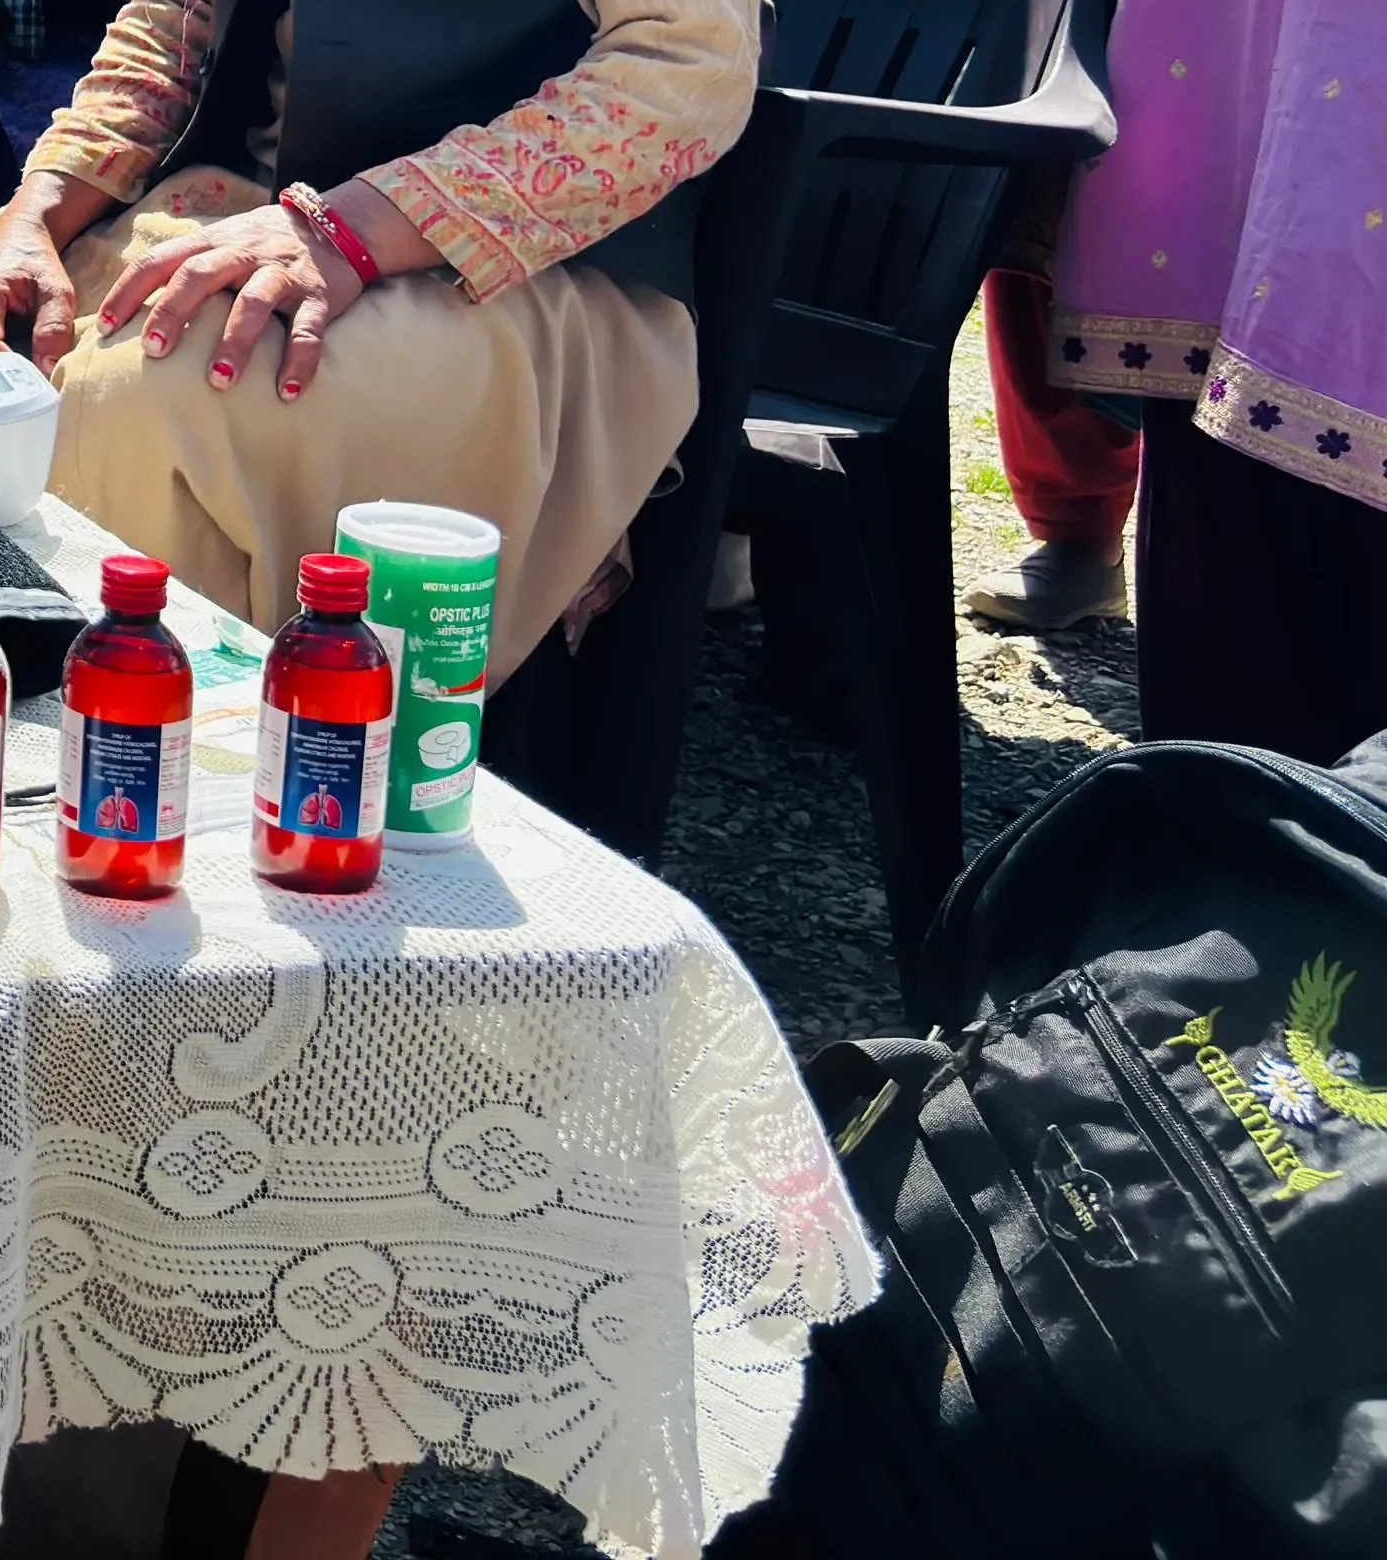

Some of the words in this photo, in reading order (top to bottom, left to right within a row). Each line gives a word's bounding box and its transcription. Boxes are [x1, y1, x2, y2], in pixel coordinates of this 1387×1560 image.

[430, 607, 471, 622] OPSTIC
[472, 603, 490, 620] PLUS
[416, 775, 459, 797] OPSTIC
[1195, 1045, 1304, 1181] GHATAK
